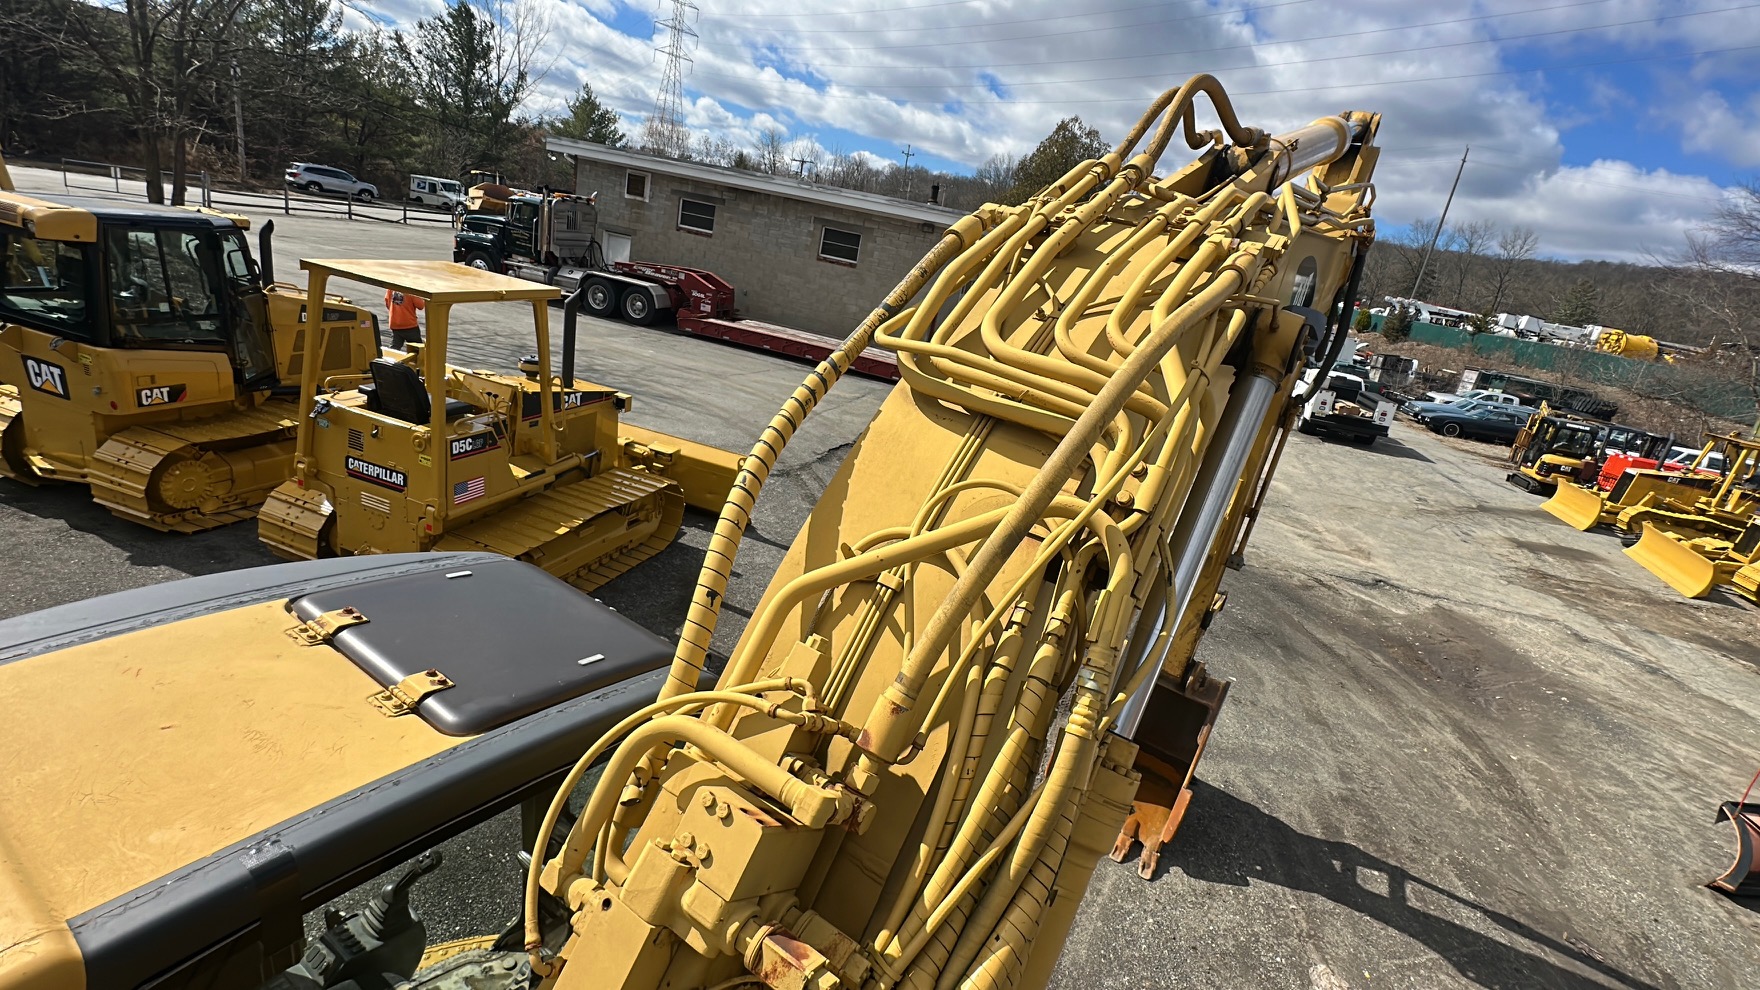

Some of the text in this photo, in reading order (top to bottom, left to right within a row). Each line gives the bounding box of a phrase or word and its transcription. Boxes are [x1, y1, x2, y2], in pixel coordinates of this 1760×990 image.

[27, 359, 64, 395] CAT
[141, 387, 170, 405] CAT
[452, 438, 472, 454] D5C
[348, 458, 404, 486] CATERPILLAR
